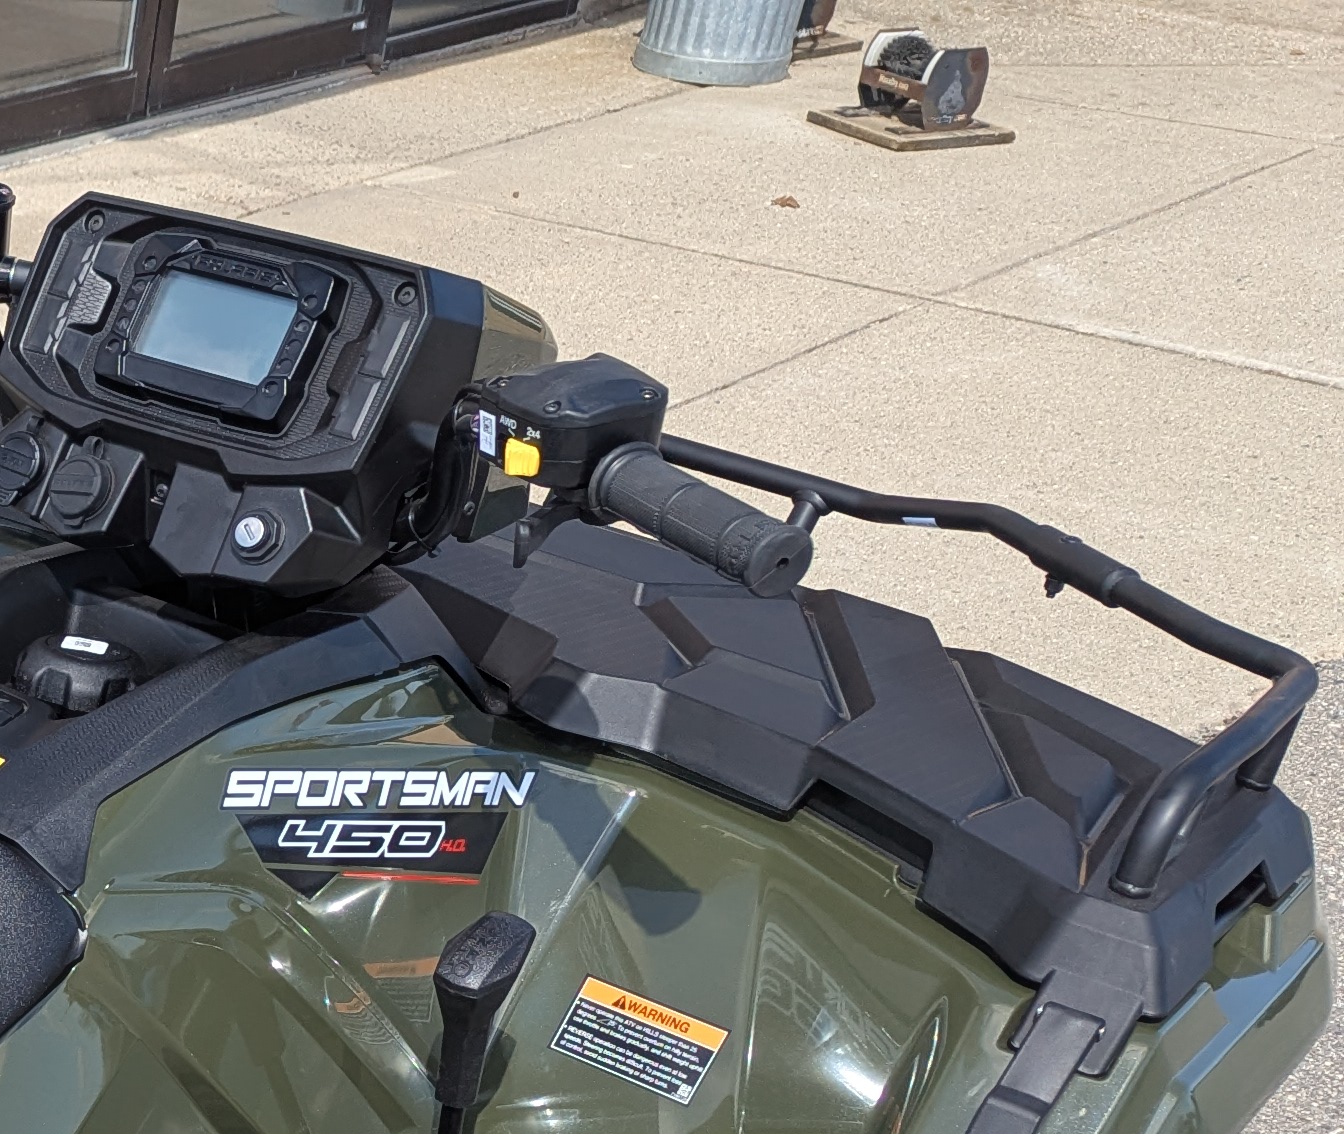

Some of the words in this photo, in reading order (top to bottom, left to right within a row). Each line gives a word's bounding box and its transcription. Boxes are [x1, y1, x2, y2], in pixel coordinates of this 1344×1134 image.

[499, 414, 517, 430] AWD
[222, 770, 536, 807] SPORTSMAN
[277, 819, 446, 859] 450
[628, 1001, 690, 1033] WARNING
